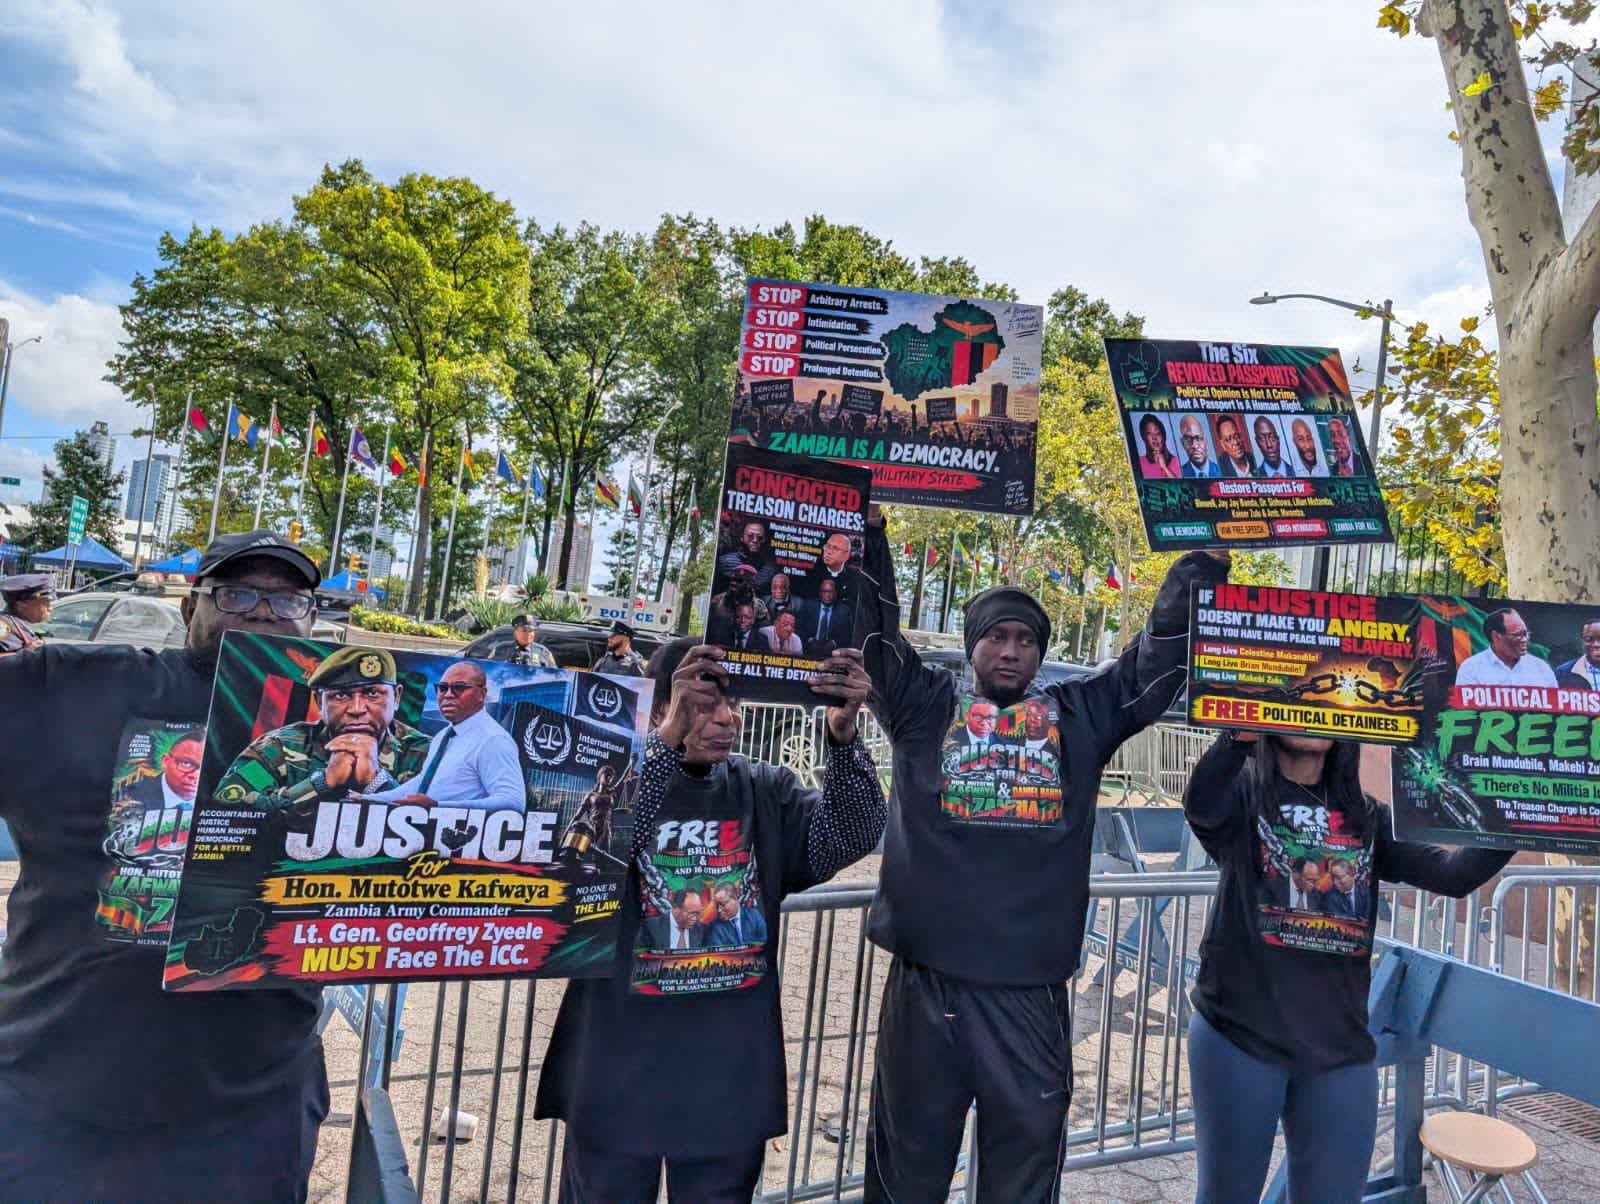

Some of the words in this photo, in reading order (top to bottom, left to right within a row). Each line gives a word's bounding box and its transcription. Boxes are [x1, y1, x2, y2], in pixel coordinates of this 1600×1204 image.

[758, 286, 802, 305] STOP
[810, 294, 848, 308] Arbitrary
[850, 297, 884, 311] Arrests.
[756, 310, 800, 328] STOP
[808, 317, 859, 331] Intimidation.
[753, 332, 797, 350] STOP
[805, 340, 836, 352] Political
[838, 343, 884, 356] Persecution.
[1199, 342, 1230, 364] The
[1231, 343, 1259, 364] Six
[750, 356, 795, 375] STOP
[804, 363, 841, 376] Prolonged
[842, 366, 880, 378] Detention.
[1166, 361, 1227, 384] REVOKED
[1228, 363, 1300, 388] PASSPORTS
[1176, 386, 1210, 398] Political
[1210, 387, 1241, 400] Opinion
[1241, 388, 1249, 399] Is
[1250, 388, 1264, 400] Not
[1265, 390, 1271, 400] A
[1272, 390, 1298, 401] Crime.
[1176, 398, 1192, 409] But
[1192, 398, 1200, 409] A
[1200, 399, 1236, 412] Passport
[1236, 400, 1244, 410] Is
[1245, 400, 1252, 410] A
[1252, 400, 1280, 411] Human
[768, 432, 846, 456] ZAMBIA
[852, 439, 869, 458] IS
[871, 440, 885, 460] A
[888, 442, 1001, 472] DEMOCRACY.
[872, 468, 925, 483] MILITARY
[928, 474, 967, 487] STATE.
[735, 466, 862, 511] CONCOCTED
[1218, 481, 1251, 494] Restore
[1251, 482, 1291, 496] Passports
[1292, 482, 1305, 493] For
[728, 490, 796, 521] TREASON
[798, 504, 865, 532] CHARGES:
[1160, 528, 1175, 537] VIVA
[1334, 522, 1355, 532] ZAMBIA
[1355, 522, 1367, 531] FOR
[1198, 589, 1215, 604] IF
[1216, 584, 1376, 621] INJUSTICE
[600, 608, 654, 623] POLCE
[1198, 609, 1253, 627] DOESN'T
[1256, 614, 1295, 631] MAKE
[1298, 616, 1325, 633] YOU
[1327, 618, 1411, 643] ANGRY,
[1198, 626, 1221, 637] THEN
[1223, 627, 1239, 638] YOU
[1240, 628, 1262, 641] HAVE
[1264, 630, 1288, 642] MADE
[1289, 632, 1317, 646] PEACE
[1318, 635, 1340, 648] WITH
[1342, 638, 1414, 659] SLAVERY.
[1204, 644, 1221, 656] Long
[1222, 646, 1238, 655] Live
[728, 651, 740, 662] THE
[741, 653, 762, 664] BOGUS
[763, 655, 792, 667] CHARGES
[1204, 656, 1221, 668] Long
[1223, 659, 1239, 668] Live
[1240, 660, 1260, 670] Brian
[744, 664, 763, 677] ALL
[764, 666, 784, 679] THE
[1202, 670, 1220, 681] Long
[1222, 672, 1237, 681] Live
[1461, 687, 1553, 710] POLITICAL
[1201, 697, 1260, 722] FREE
[1263, 706, 1329, 726] POLITICAL
[578, 732, 625, 754] International
[1436, 709, 1600, 761] FREE
[576, 744, 609, 760] Criminal
[576, 753, 598, 767] Court
[1462, 754, 1489, 768] Brain
[1492, 756, 1546, 772] Mundubile,
[1548, 760, 1585, 773] Makebi
[996, 769, 1016, 780] FOR
[998, 782, 1011, 800] &
[1482, 778, 1529, 793] There's
[1532, 782, 1549, 795] No
[1552, 783, 1590, 799] Militia
[200, 810, 267, 819] ACCOUNTABILITY
[1496, 800, 1512, 809] The
[1512, 801, 1546, 812] Treason
[1548, 803, 1578, 815] Charge
[198, 818, 231, 826] JUSTICE
[1505, 810, 1519, 820] Mr.
[1520, 812, 1560, 823] Hichilema
[196, 827, 227, 835] HUMAN
[285, 801, 558, 864] JUSTICE
[657, 820, 743, 853] FREE
[192, 852, 225, 860] ZAMBIA
[194, 844, 211, 852] FOR
[212, 844, 219, 852] A
[220, 844, 252, 852] BETTER
[688, 847, 718, 857] BRIAN
[405, 851, 450, 880] For
[699, 855, 707, 866] &
[120, 867, 145, 877] HON.
[704, 864, 732, 875] OTHERS
[283, 878, 341, 899] Hon.
[348, 879, 451, 899] Mutotwe
[456, 880, 549, 903] Kafwaya
[576, 886, 589, 896] NO
[590, 884, 608, 894] ONE
[608, 882, 617, 892] IS
[580, 892, 609, 903] ABOVE
[324, 904, 381, 919] Zambia
[386, 905, 423, 920] Army
[429, 904, 512, 917] Commander
[575, 903, 595, 915] THE
[596, 900, 621, 912] LAW.
[294, 924, 324, 944] Lt.
[329, 924, 381, 943] Gen.
[386, 924, 480, 945] Geoffrey
[482, 922, 544, 942] Zyeele
[302, 946, 382, 973] MUST
[385, 947, 438, 969] Face
[442, 946, 485, 967] The
[490, 944, 529, 966] ICC.
[1085, 939, 1123, 965] POLE
